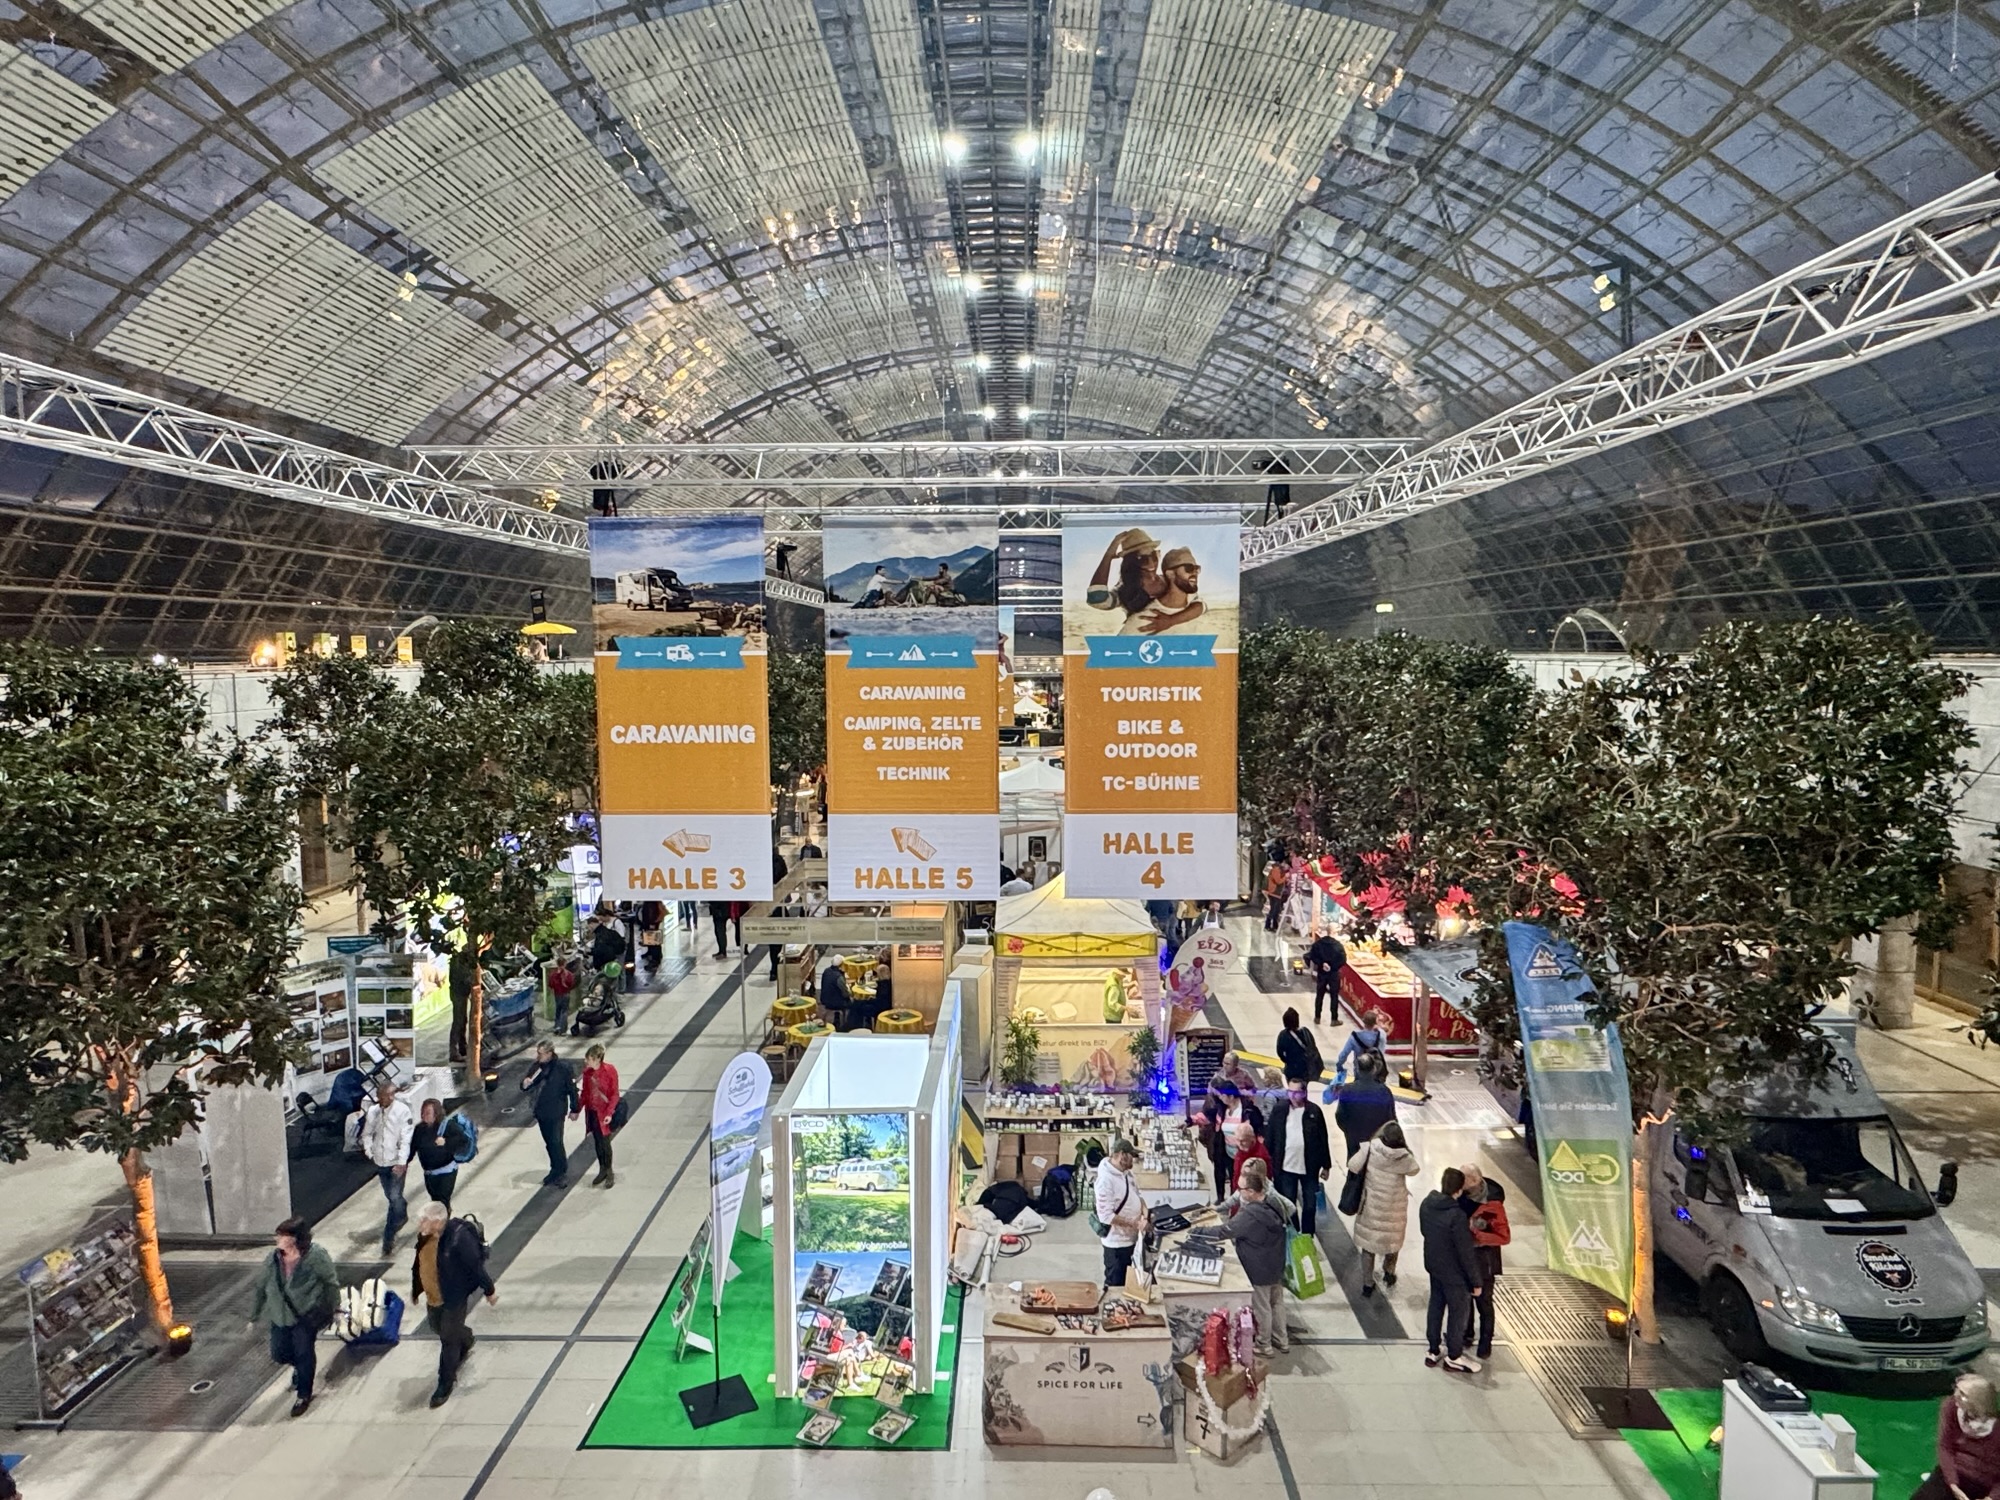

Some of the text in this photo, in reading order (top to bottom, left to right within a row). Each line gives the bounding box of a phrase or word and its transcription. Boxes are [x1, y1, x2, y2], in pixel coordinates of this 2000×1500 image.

[859, 685, 966, 701] CARAVANING
[1100, 686, 1202, 703] TOURISTIK
[843, 716, 982, 734] CAMPING, ZELTE
[1117, 719, 1184, 735] BIKE &
[610, 724, 756, 745] CARAVANING
[862, 734, 964, 751] & ZUBEHÖR
[1104, 742, 1198, 759] OUTDOOR
[876, 766, 951, 781] TECHNIK
[1101, 772, 1200, 791] TC-BÜHNE
[1103, 832, 1195, 855] HALLE
[628, 867, 747, 890] HALLE 3
[855, 867, 974, 890] HALLE 5
[1140, 863, 1165, 889] 4
[1037, 1380, 1123, 1389] SPICE FOR LIFE
